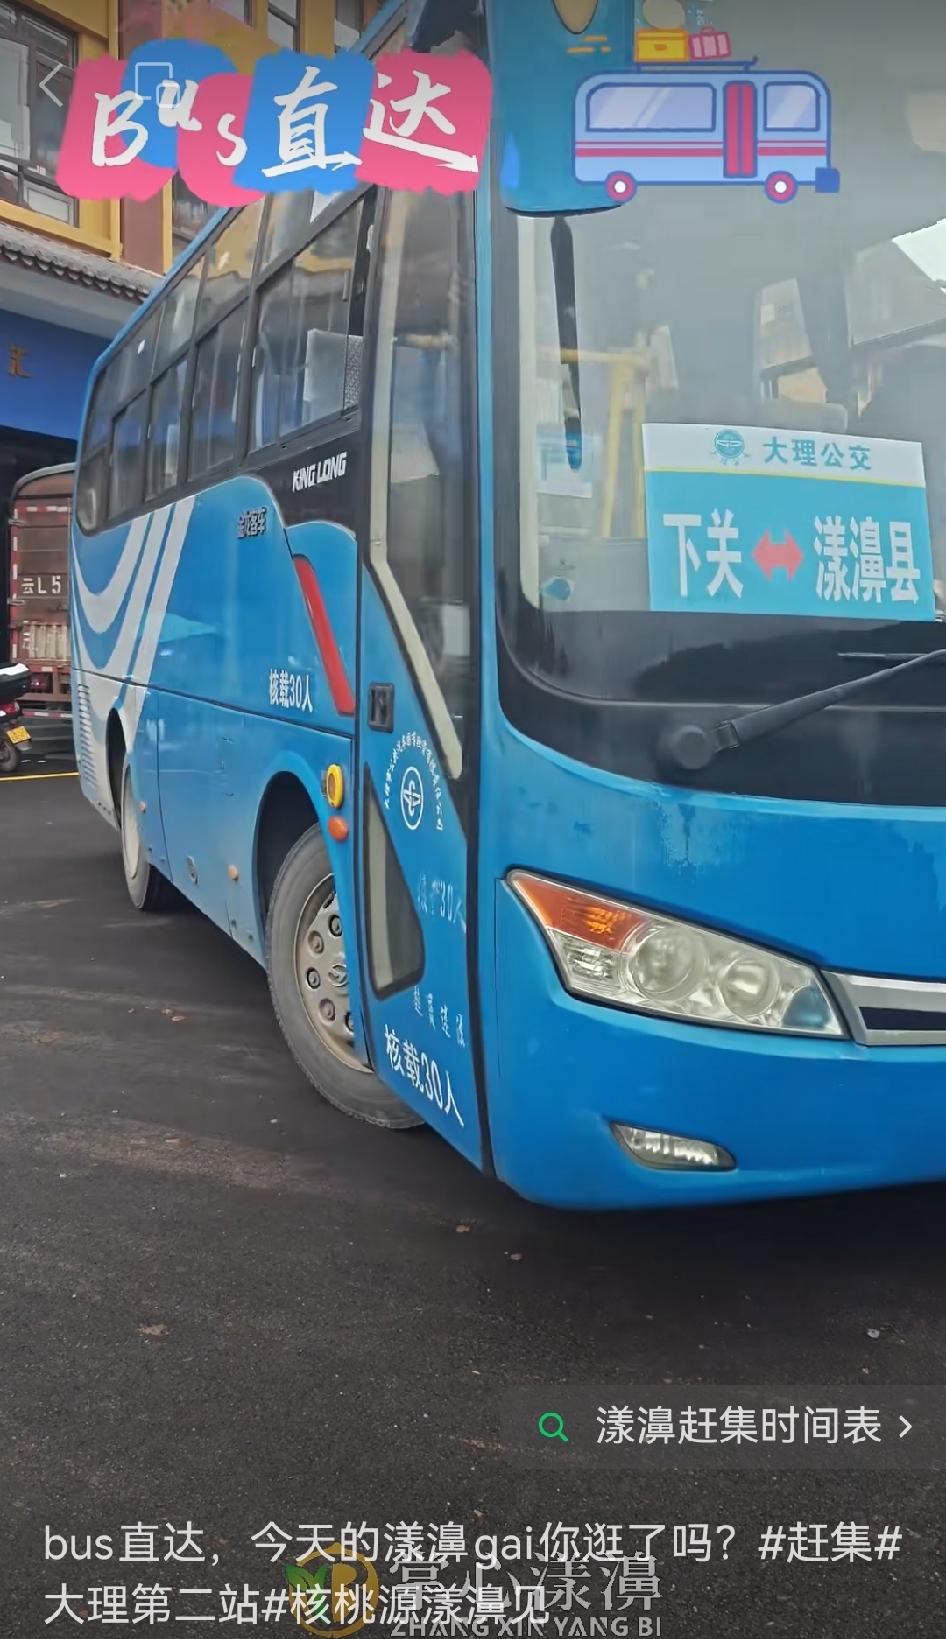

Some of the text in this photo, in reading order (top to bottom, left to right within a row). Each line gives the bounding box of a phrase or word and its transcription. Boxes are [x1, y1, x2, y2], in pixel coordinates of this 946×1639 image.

[292, 452, 348, 493] KING LONG
[762, 436, 873, 471] 大理公交
[662, 508, 921, 604] 下关 漾濞县
[269, 668, 314, 713] 核载30人
[384, 1023, 465, 1128] 核载30人
